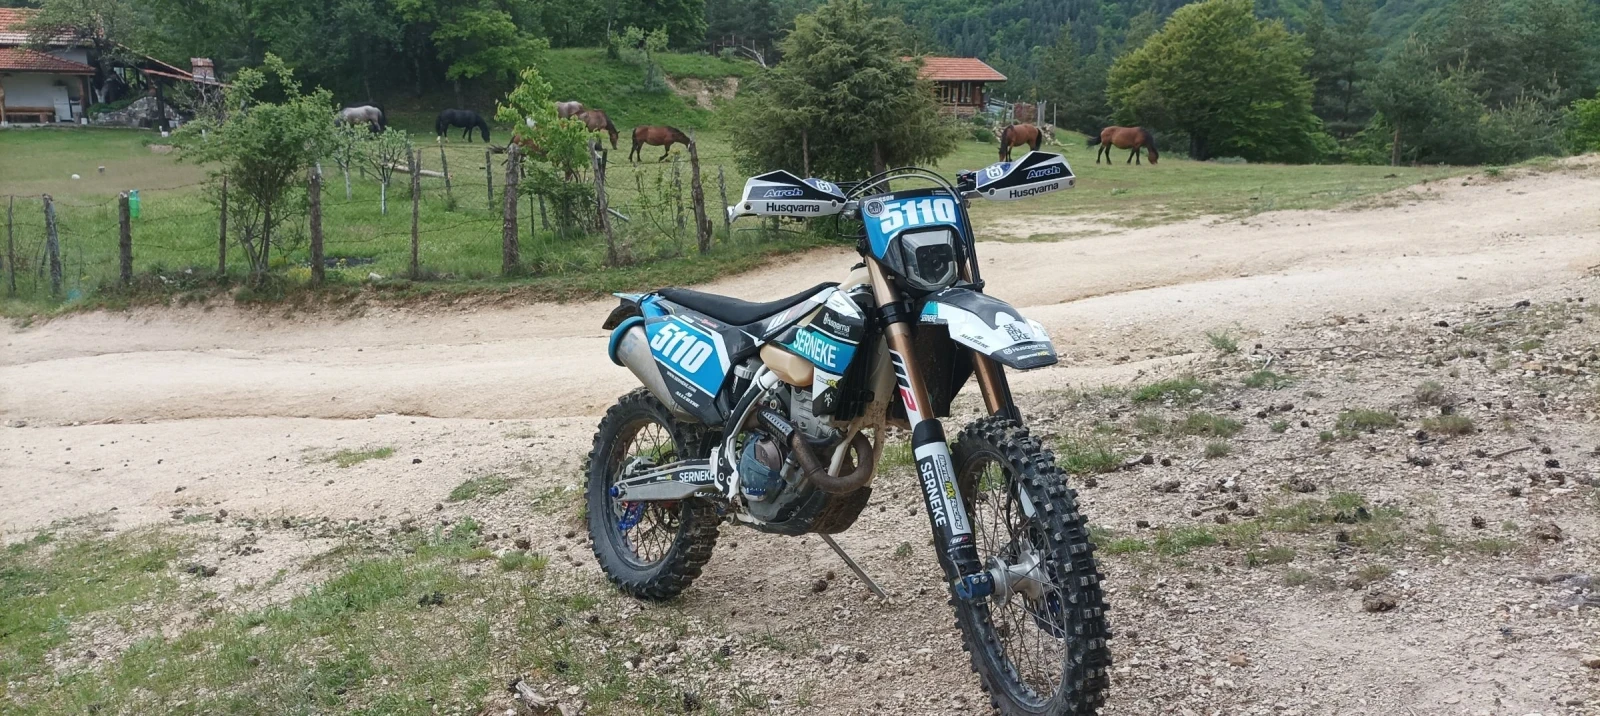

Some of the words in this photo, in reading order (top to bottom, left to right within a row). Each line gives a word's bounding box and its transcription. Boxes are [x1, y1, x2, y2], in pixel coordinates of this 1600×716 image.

[1026, 166, 1061, 179] Airoh
[763, 188, 803, 198] Airoh
[1009, 182, 1059, 199] Husqvarna
[766, 202, 820, 214] Husqvarna
[879, 198, 957, 234] 5110
[650, 322, 713, 374] 5110
[793, 328, 837, 368] SERNEKE
[679, 470, 715, 483] SERNEKE
[920, 461, 947, 527] SERNEKE
